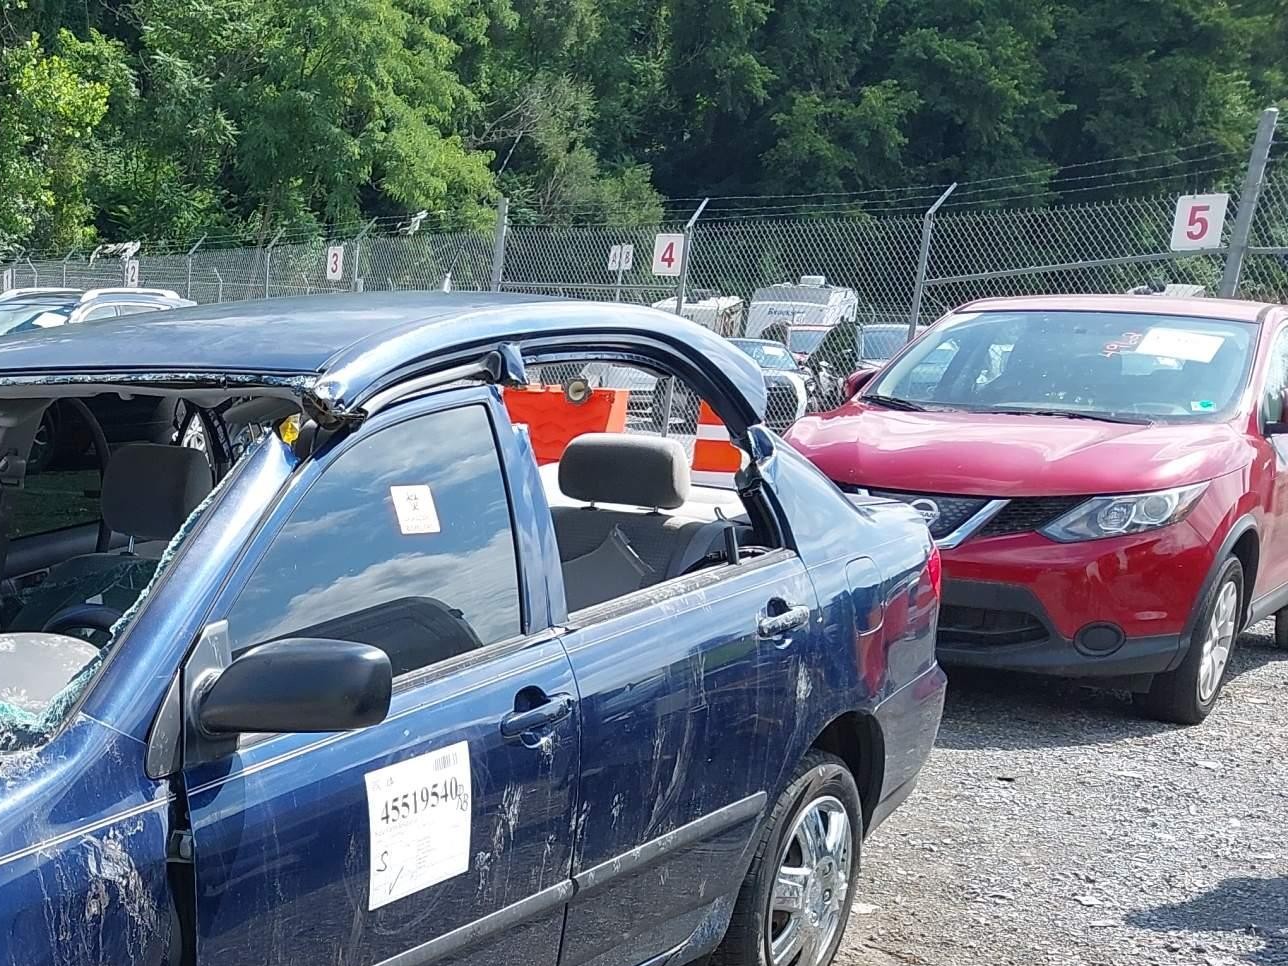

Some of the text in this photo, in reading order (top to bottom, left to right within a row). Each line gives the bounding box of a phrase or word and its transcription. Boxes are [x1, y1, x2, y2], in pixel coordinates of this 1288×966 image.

[1186, 205, 1210, 240] 5
[331, 253, 338, 273] 3
[661, 242, 674, 268] 4
[130, 265, 136, 282] 2
[381, 777, 457, 824] 45519540
